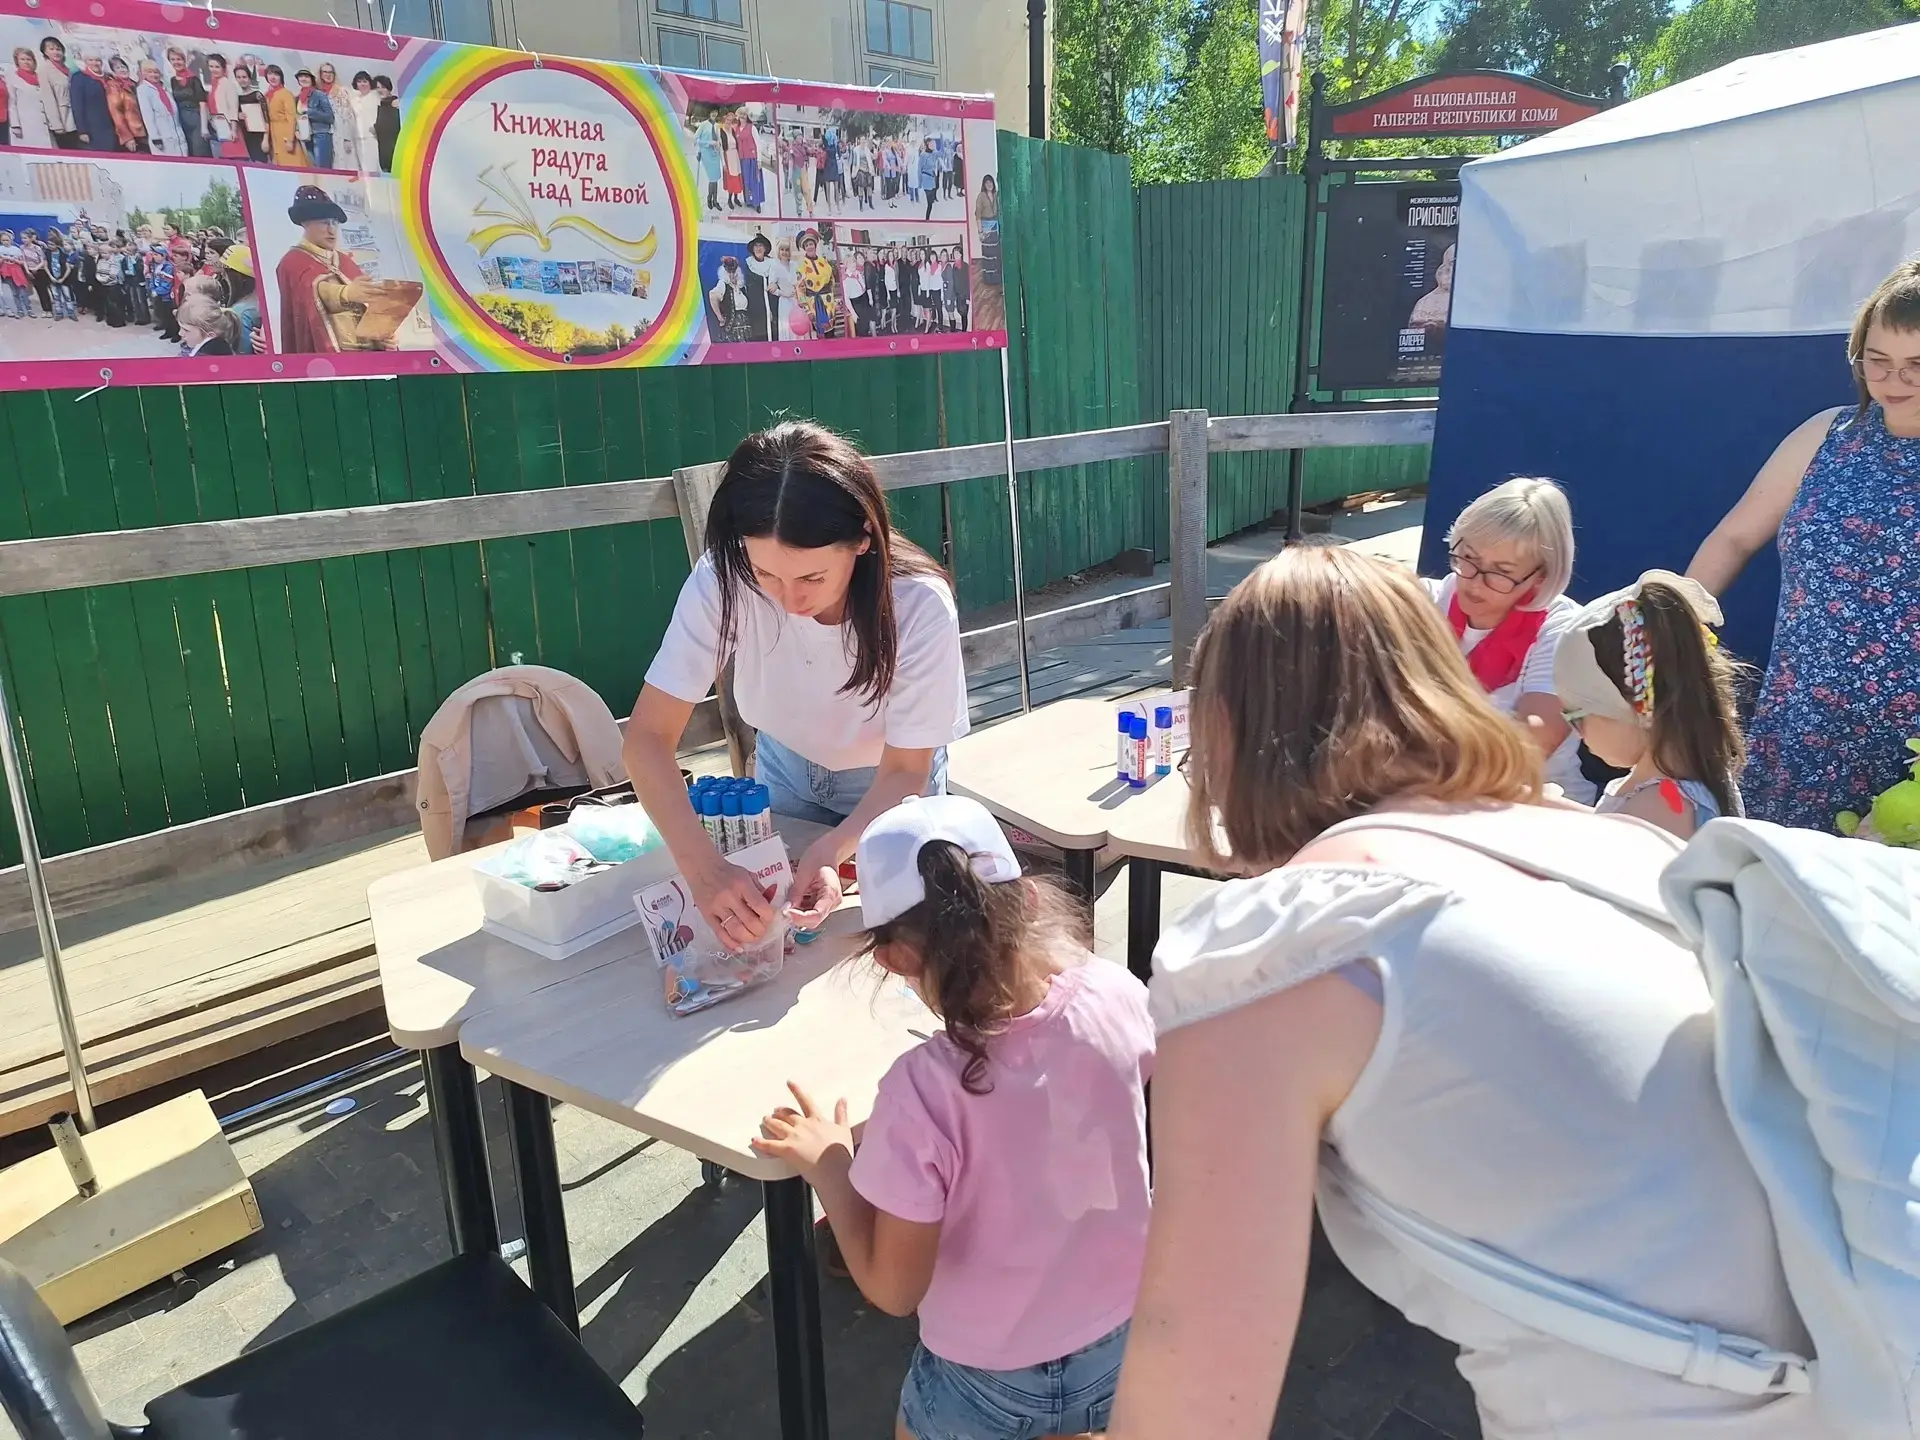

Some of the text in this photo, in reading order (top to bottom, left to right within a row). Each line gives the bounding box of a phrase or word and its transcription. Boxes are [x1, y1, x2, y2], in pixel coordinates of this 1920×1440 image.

[1412, 91, 1517, 108] НАЦИОНАЛЬНАЯ
[490, 102, 606, 141] Книжная
[1373, 107, 1559, 127] ГАЛЕРЕЯ РЕСПУБЛИКИ КОМИ
[531, 148, 608, 179] радуга
[528, 177, 649, 208] над Емвой
[756, 861, 784, 879] капа
